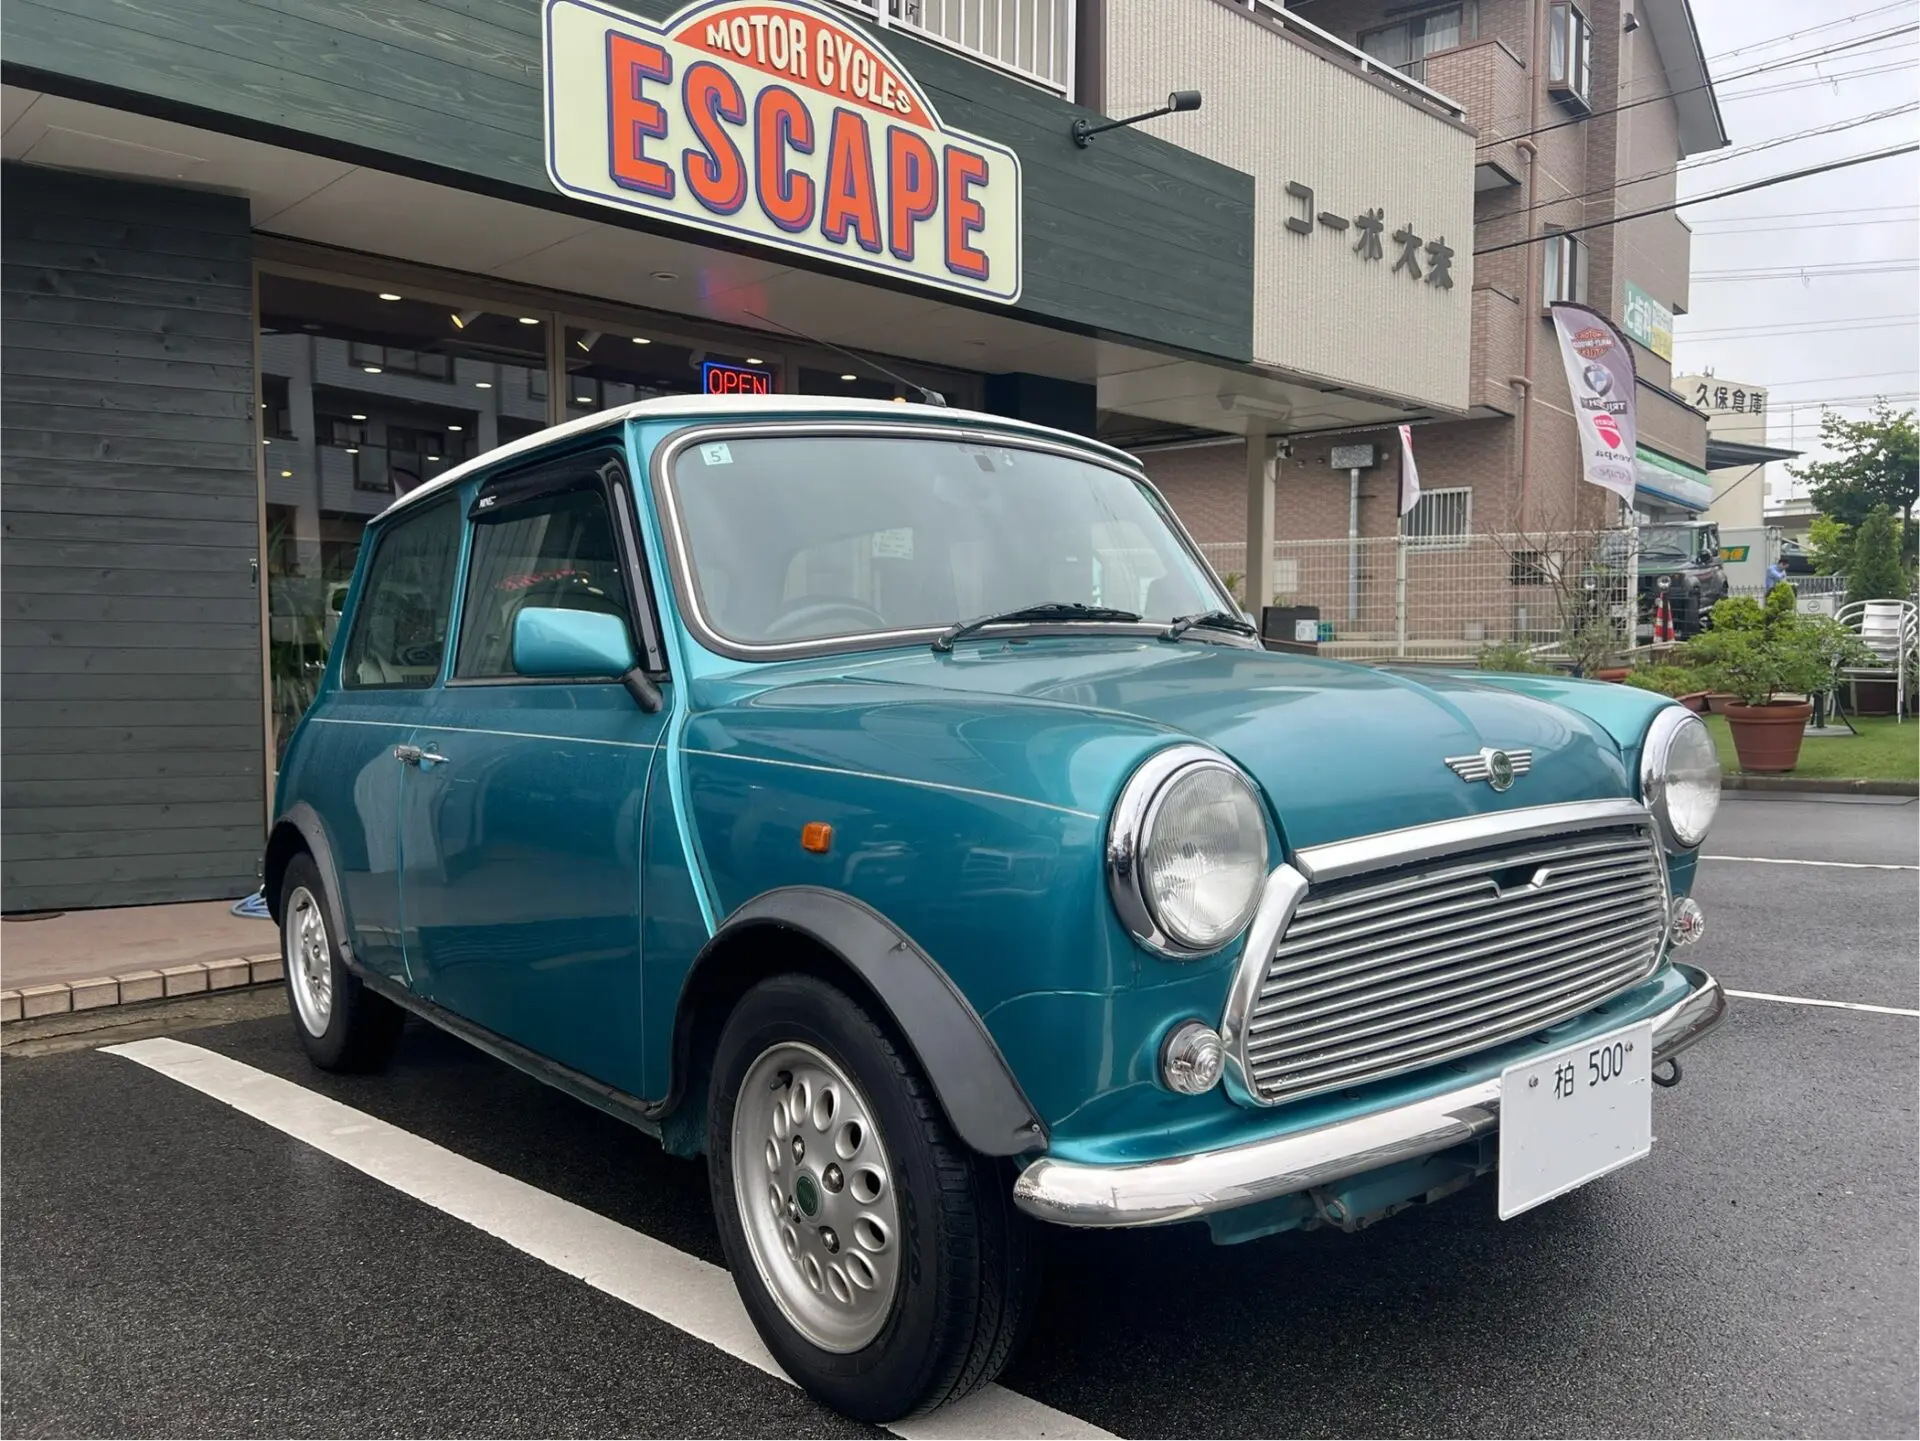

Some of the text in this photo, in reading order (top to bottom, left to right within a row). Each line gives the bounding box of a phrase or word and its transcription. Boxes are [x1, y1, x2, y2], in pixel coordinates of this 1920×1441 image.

[706, 15, 912, 114] MOTOR CYCLES
[605, 29, 989, 281] ESCAPE
[709, 369, 766, 395] OPEN
[1696, 383, 1764, 416] 久保倉庫
[710, 450, 722, 463] 5
[1554, 1042, 1623, 1099] 柏 500
